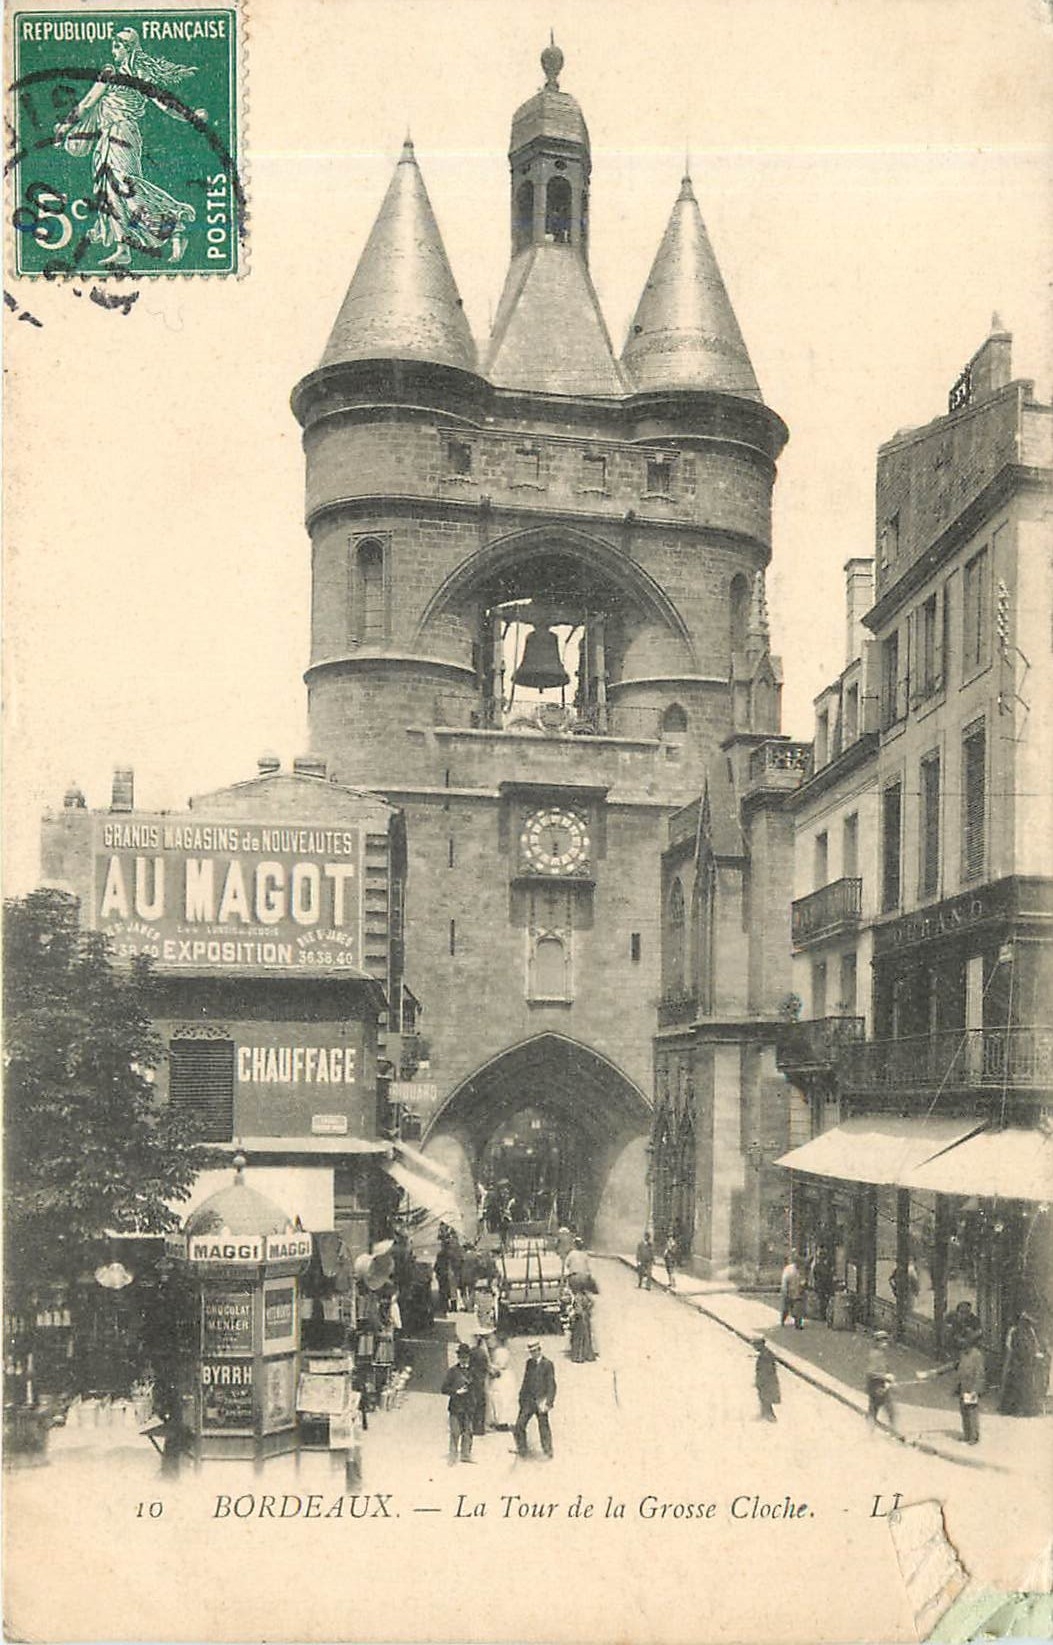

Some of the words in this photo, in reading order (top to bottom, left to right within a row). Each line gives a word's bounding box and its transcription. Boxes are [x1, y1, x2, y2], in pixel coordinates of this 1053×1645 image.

[22, 21, 115, 43] REPUBLIQUE
[142, 20, 226, 41] FRANÇAISE
[206, 173, 227, 260] POSTES
[103, 823, 158, 850] GRANDS
[164, 825, 238, 852] MAGASINS
[242, 836, 259, 852] de
[100, 854, 165, 922] AU
[185, 857, 355, 926] MAGOT
[163, 938, 292, 965] EXPOSITION
[237, 1046, 357, 1084] CHAUFFAGE
[192, 1243, 259, 1259] MAGGI
[268, 1240, 311, 1258] MAGGI
[205, 1304, 250, 1317] CHOCOLAT
[209, 1318, 250, 1331] MENIER
[202, 1365, 253, 1386] BYRRH
